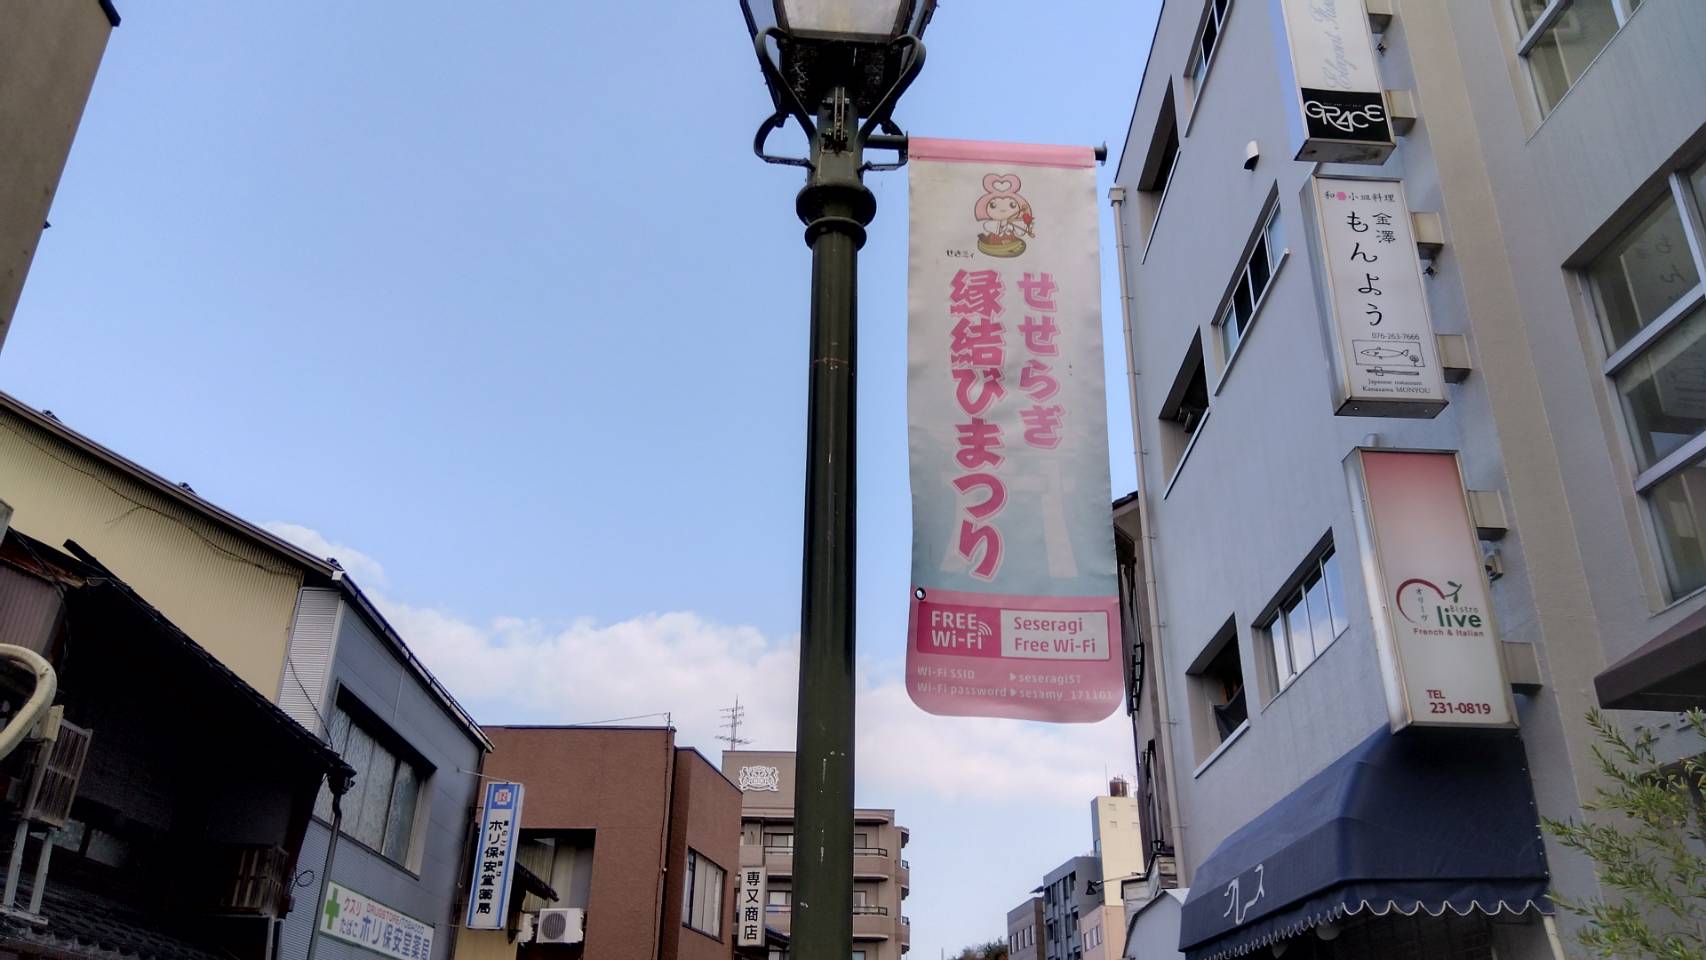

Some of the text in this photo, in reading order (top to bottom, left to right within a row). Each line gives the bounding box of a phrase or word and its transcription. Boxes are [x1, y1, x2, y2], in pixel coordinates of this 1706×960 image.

[1304, 100, 1384, 132] GRACE
[1372, 212, 1396, 243] 金澤
[1347, 211, 1383, 327] もんよう
[1016, 271, 1066, 450] せせらぎ
[1396, 386, 1431, 394] MONYOU
[949, 267, 1009, 581] 縁結びまつり
[1450, 605, 1479, 614] Bistro
[931, 610, 978, 630] FREE
[1014, 616, 1083, 635] Seseragi
[931, 629, 983, 650] Wi-Fi
[1413, 627, 1444, 636] French
[1455, 629, 1484, 637] Italian
[1014, 637, 1096, 653] Free Wi-Fi
[917, 665, 976, 680] Wi-Fi SSID
[917, 681, 1007, 697] Wi-Fi password
[1426, 689, 1446, 699] TEL
[1429, 702, 1491, 714] 231-0819
[476, 820, 503, 914] ホリ保安堂薬局
[343, 898, 361, 916] クスリ
[341, 917, 359, 938] たばこ
